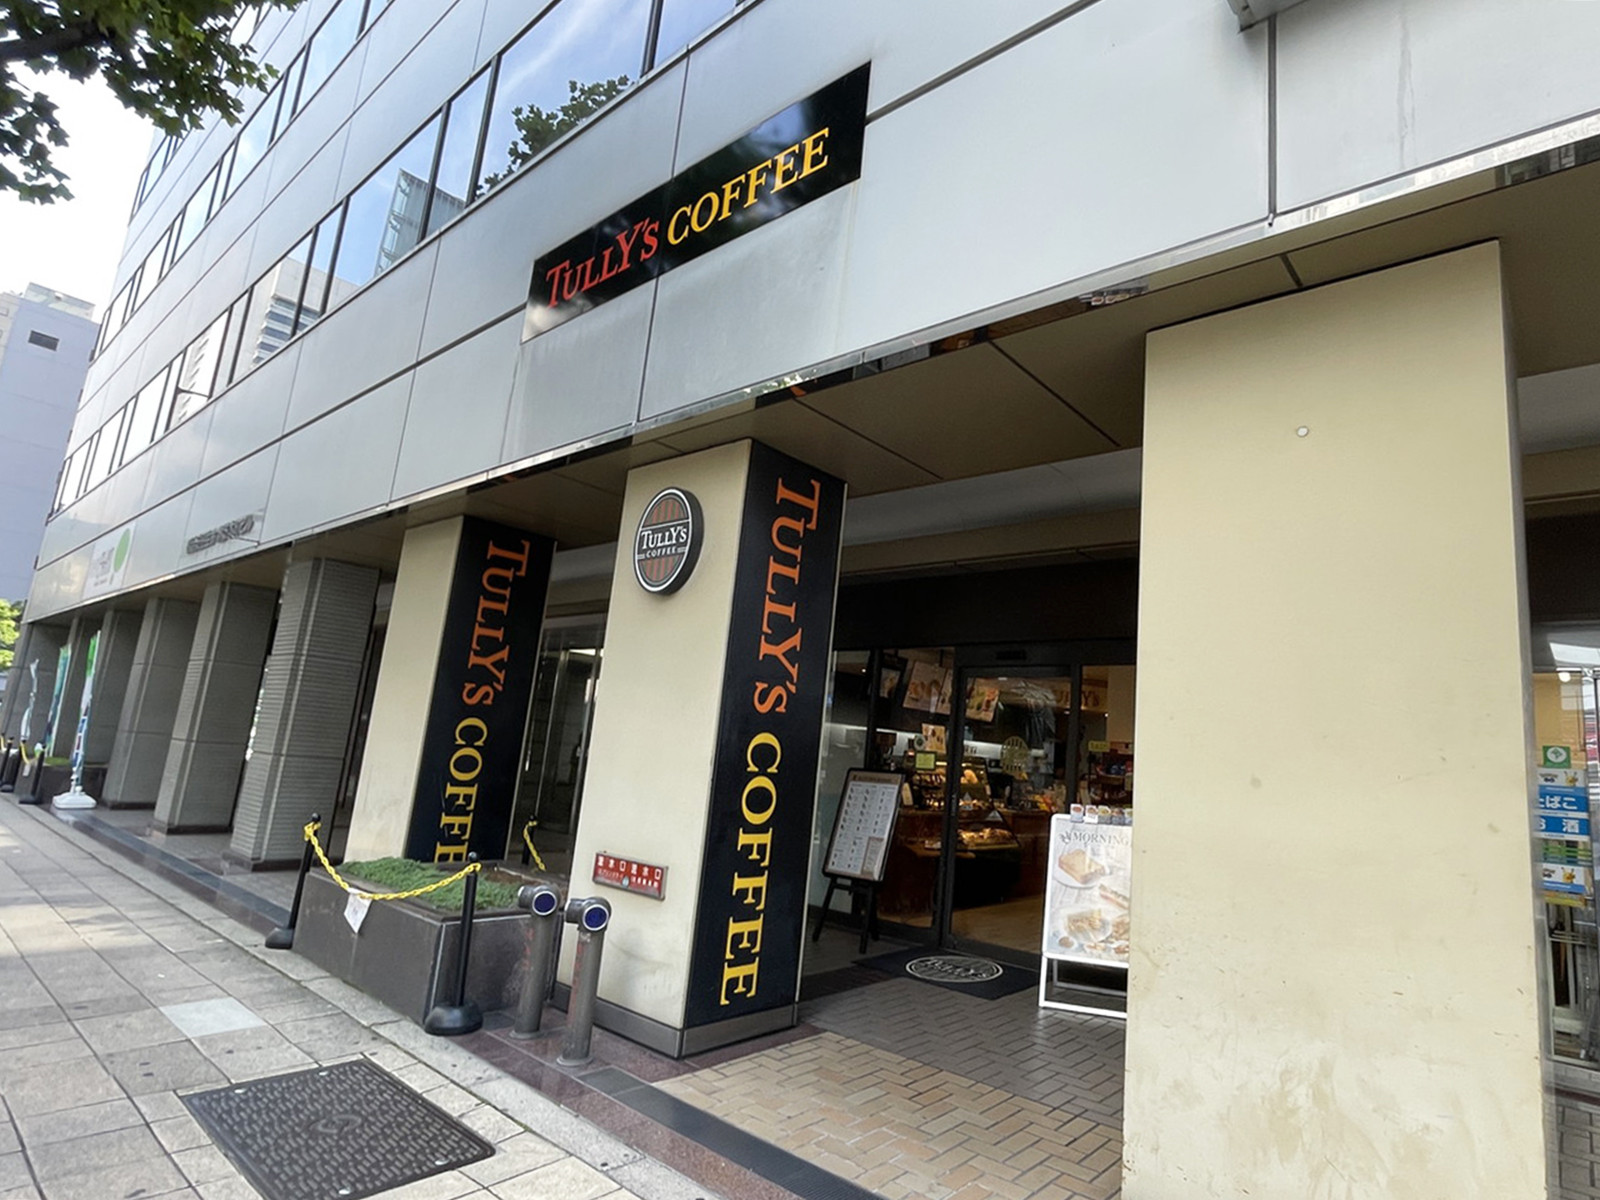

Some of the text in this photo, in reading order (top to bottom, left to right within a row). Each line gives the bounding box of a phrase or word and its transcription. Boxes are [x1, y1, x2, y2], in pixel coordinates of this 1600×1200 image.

[667, 127, 830, 246] COFFEE
[646, 546, 677, 558] COFFEE
[719, 732, 782, 1006] COFFEE
[1072, 831, 1129, 847] MORNING
